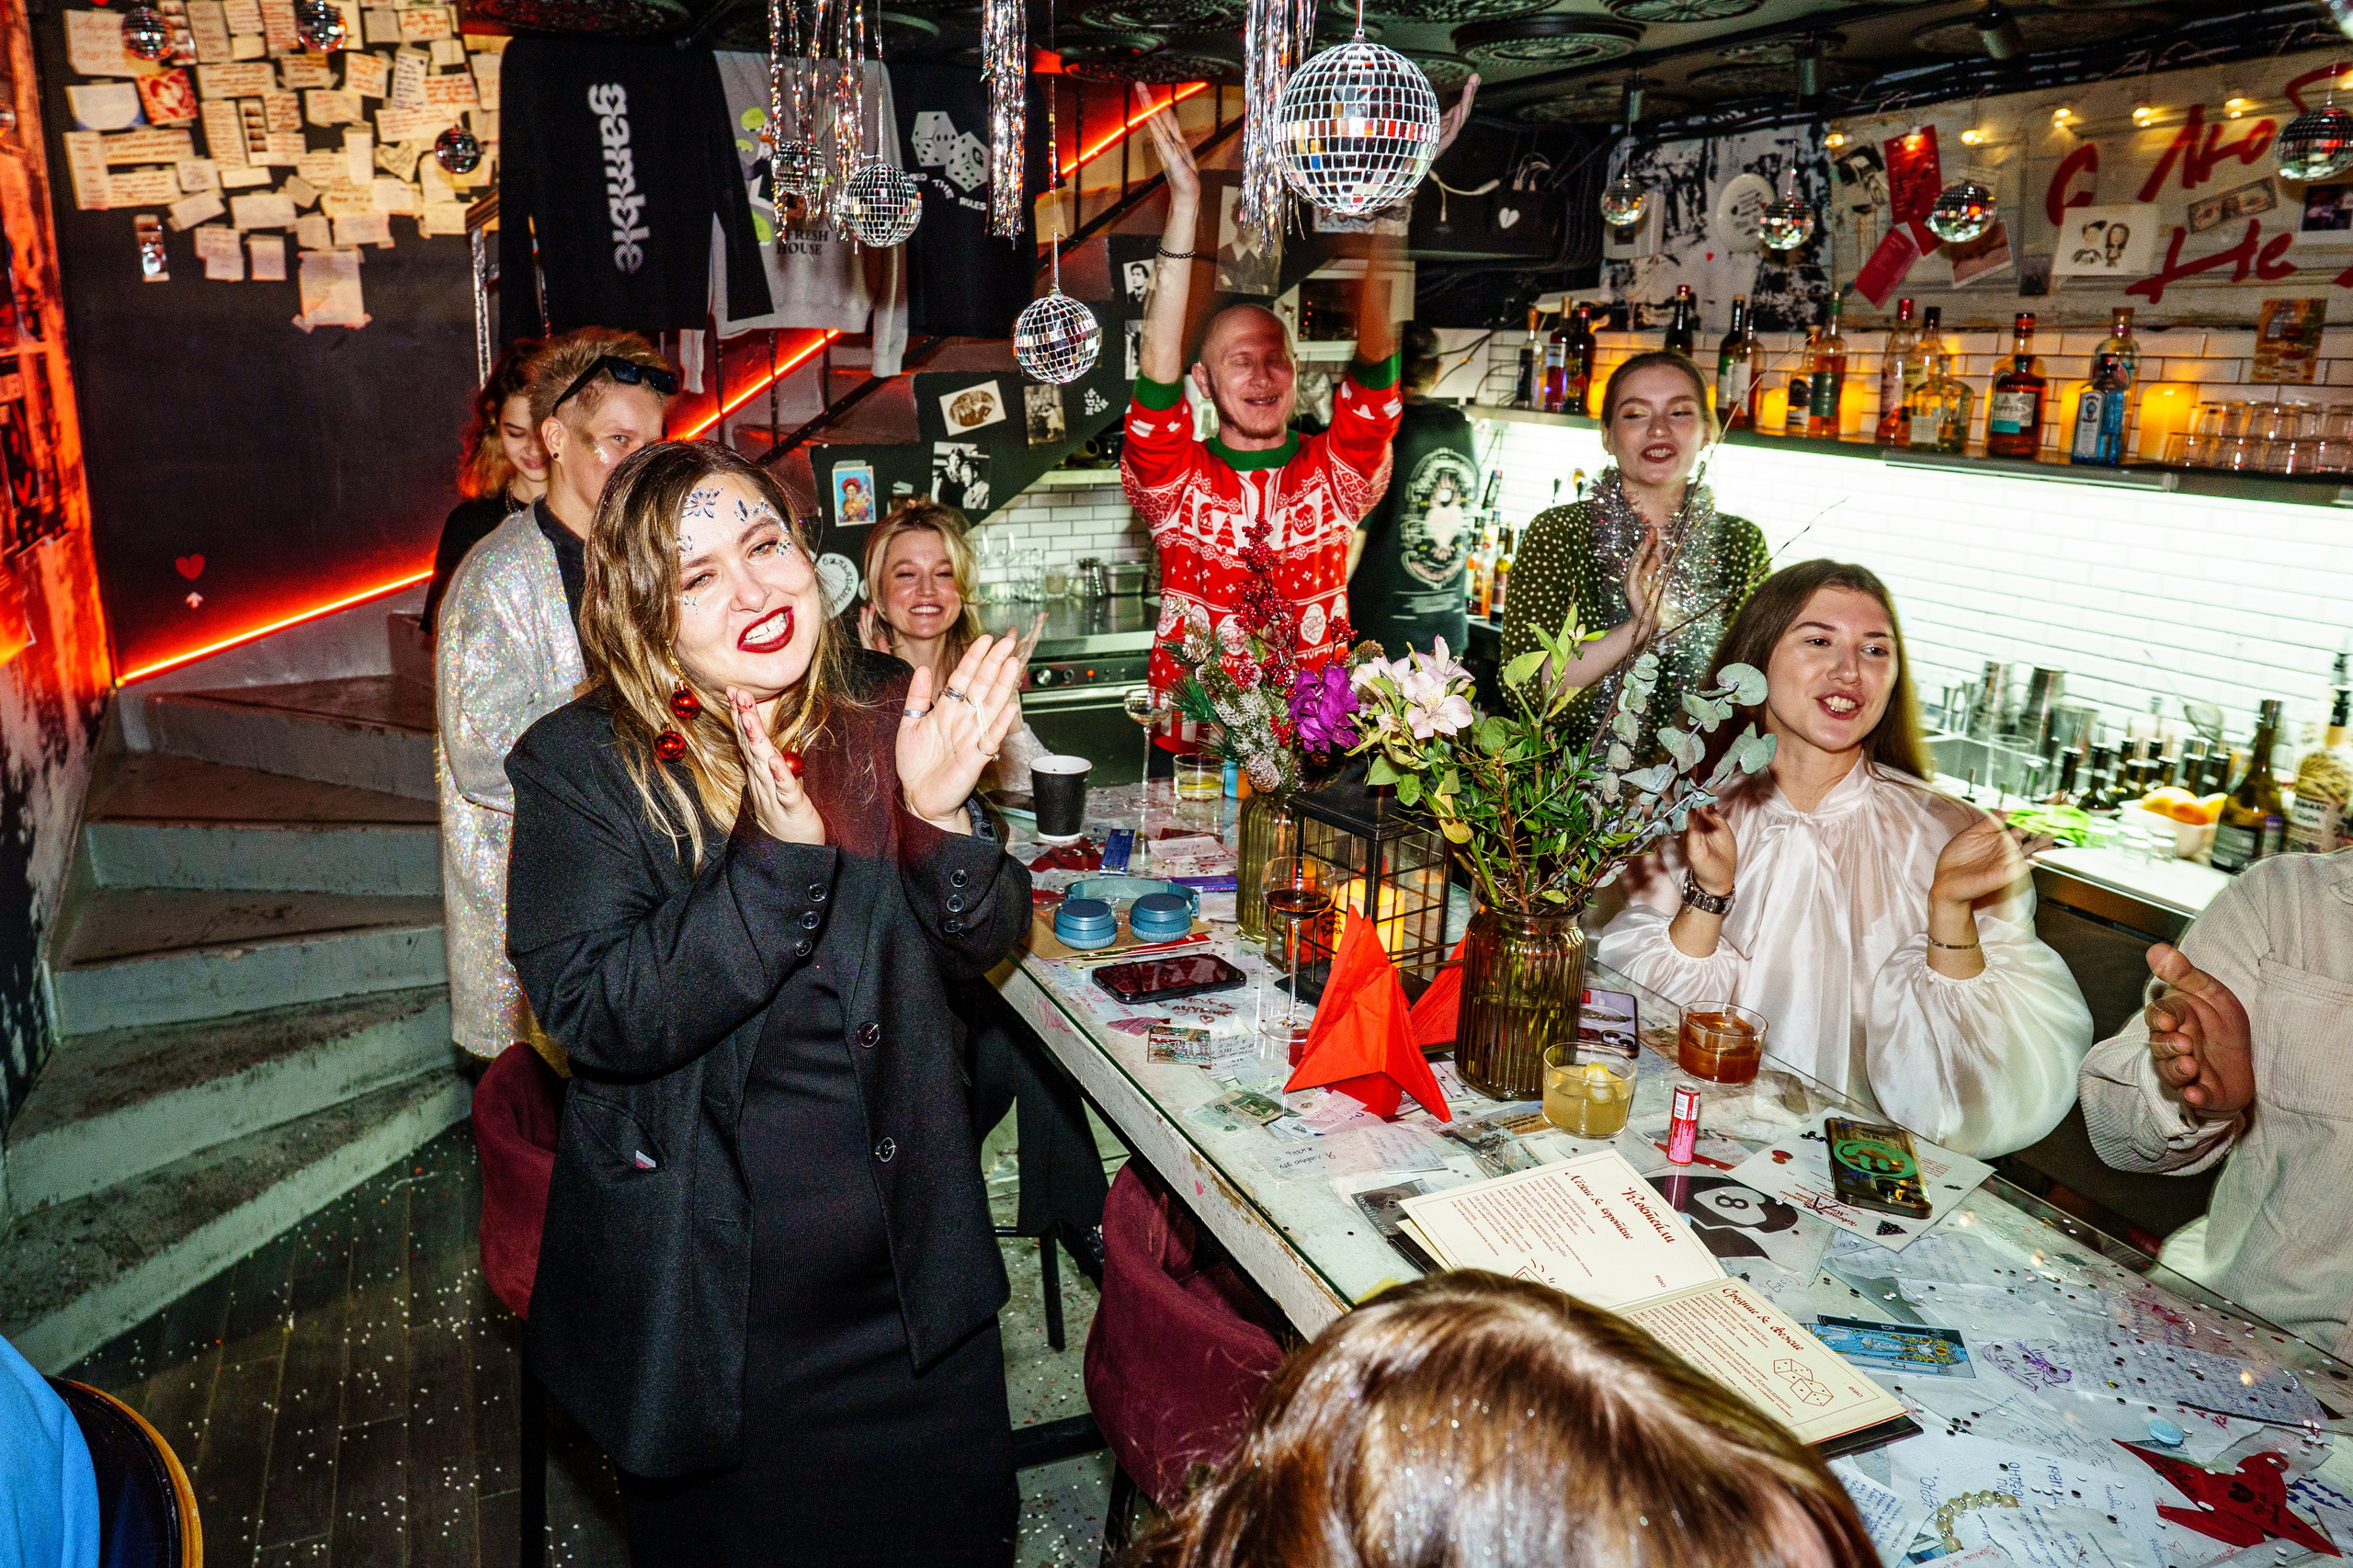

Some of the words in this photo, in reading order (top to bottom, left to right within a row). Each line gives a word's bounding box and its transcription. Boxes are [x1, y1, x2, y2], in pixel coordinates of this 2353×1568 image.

[587, 83, 650, 273] gamble
[931, 178, 954, 199] THE
[959, 197, 987, 210] RULES
[777, 242, 823, 256] HOUSE
[1285, 1147, 1313, 1156] жизнь
[1294, 1153, 1322, 1165] люблю
[1325, 1152, 1336, 1160] Я
[1457, 1199, 1477, 1221] казанова
[1518, 1185, 1531, 1197] меня
[1529, 1195, 1545, 1211] здесь
[1541, 1209, 1554, 1221] уже
[1551, 1218, 1562, 1228] нет
[1534, 1180, 1546, 1191] твой
[1544, 1192, 1568, 1216] любимый
[1567, 1215, 1579, 1227] сидр
[1548, 1176, 1571, 1199] разбитые
[1570, 1197, 1586, 1215] сердца
[1564, 1173, 1594, 1197] Лёгкие
[1600, 1208, 1633, 1240] короткие
[1478, 1202, 1501, 1227] портретов
[1500, 1224, 1525, 1253] ахматовой
[1501, 1206, 1524, 1229] цветочки
[1507, 1192, 1525, 1209] всегда
[1521, 1207, 1533, 1218] буду
[1532, 1219, 1552, 1241] помнить
[1556, 1245, 1566, 1257] тебе
[1620, 1187, 1676, 1244] Коктейли
[1655, 1275, 1665, 1288] 690
[1653, 1308, 1678, 1328] русский
[1677, 1325, 1695, 1341] пунш
[1680, 1301, 1707, 1320] хроники
[1695, 1297, 1720, 1317] фиалки
[1714, 1313, 1737, 1330] насти
[1709, 1292, 1748, 1324] клубничный
[1722, 1289, 1759, 1314] Средние
[1756, 1316, 1770, 1324] &
[1769, 1326, 1804, 1351] свежие
[1632, 1312, 1645, 1323] как
[1650, 1327, 1664, 1338] сид
[1665, 1341, 1685, 1356] нэнси
[1639, 1312, 1652, 1321] мы
[1648, 1319, 1669, 1335] будем
[1667, 1335, 1688, 1352] всегда
[1711, 1341, 1756, 1379] предпочитают
[1756, 1378, 1792, 1409] блондинок
[1848, 1387, 1863, 1397] 690
